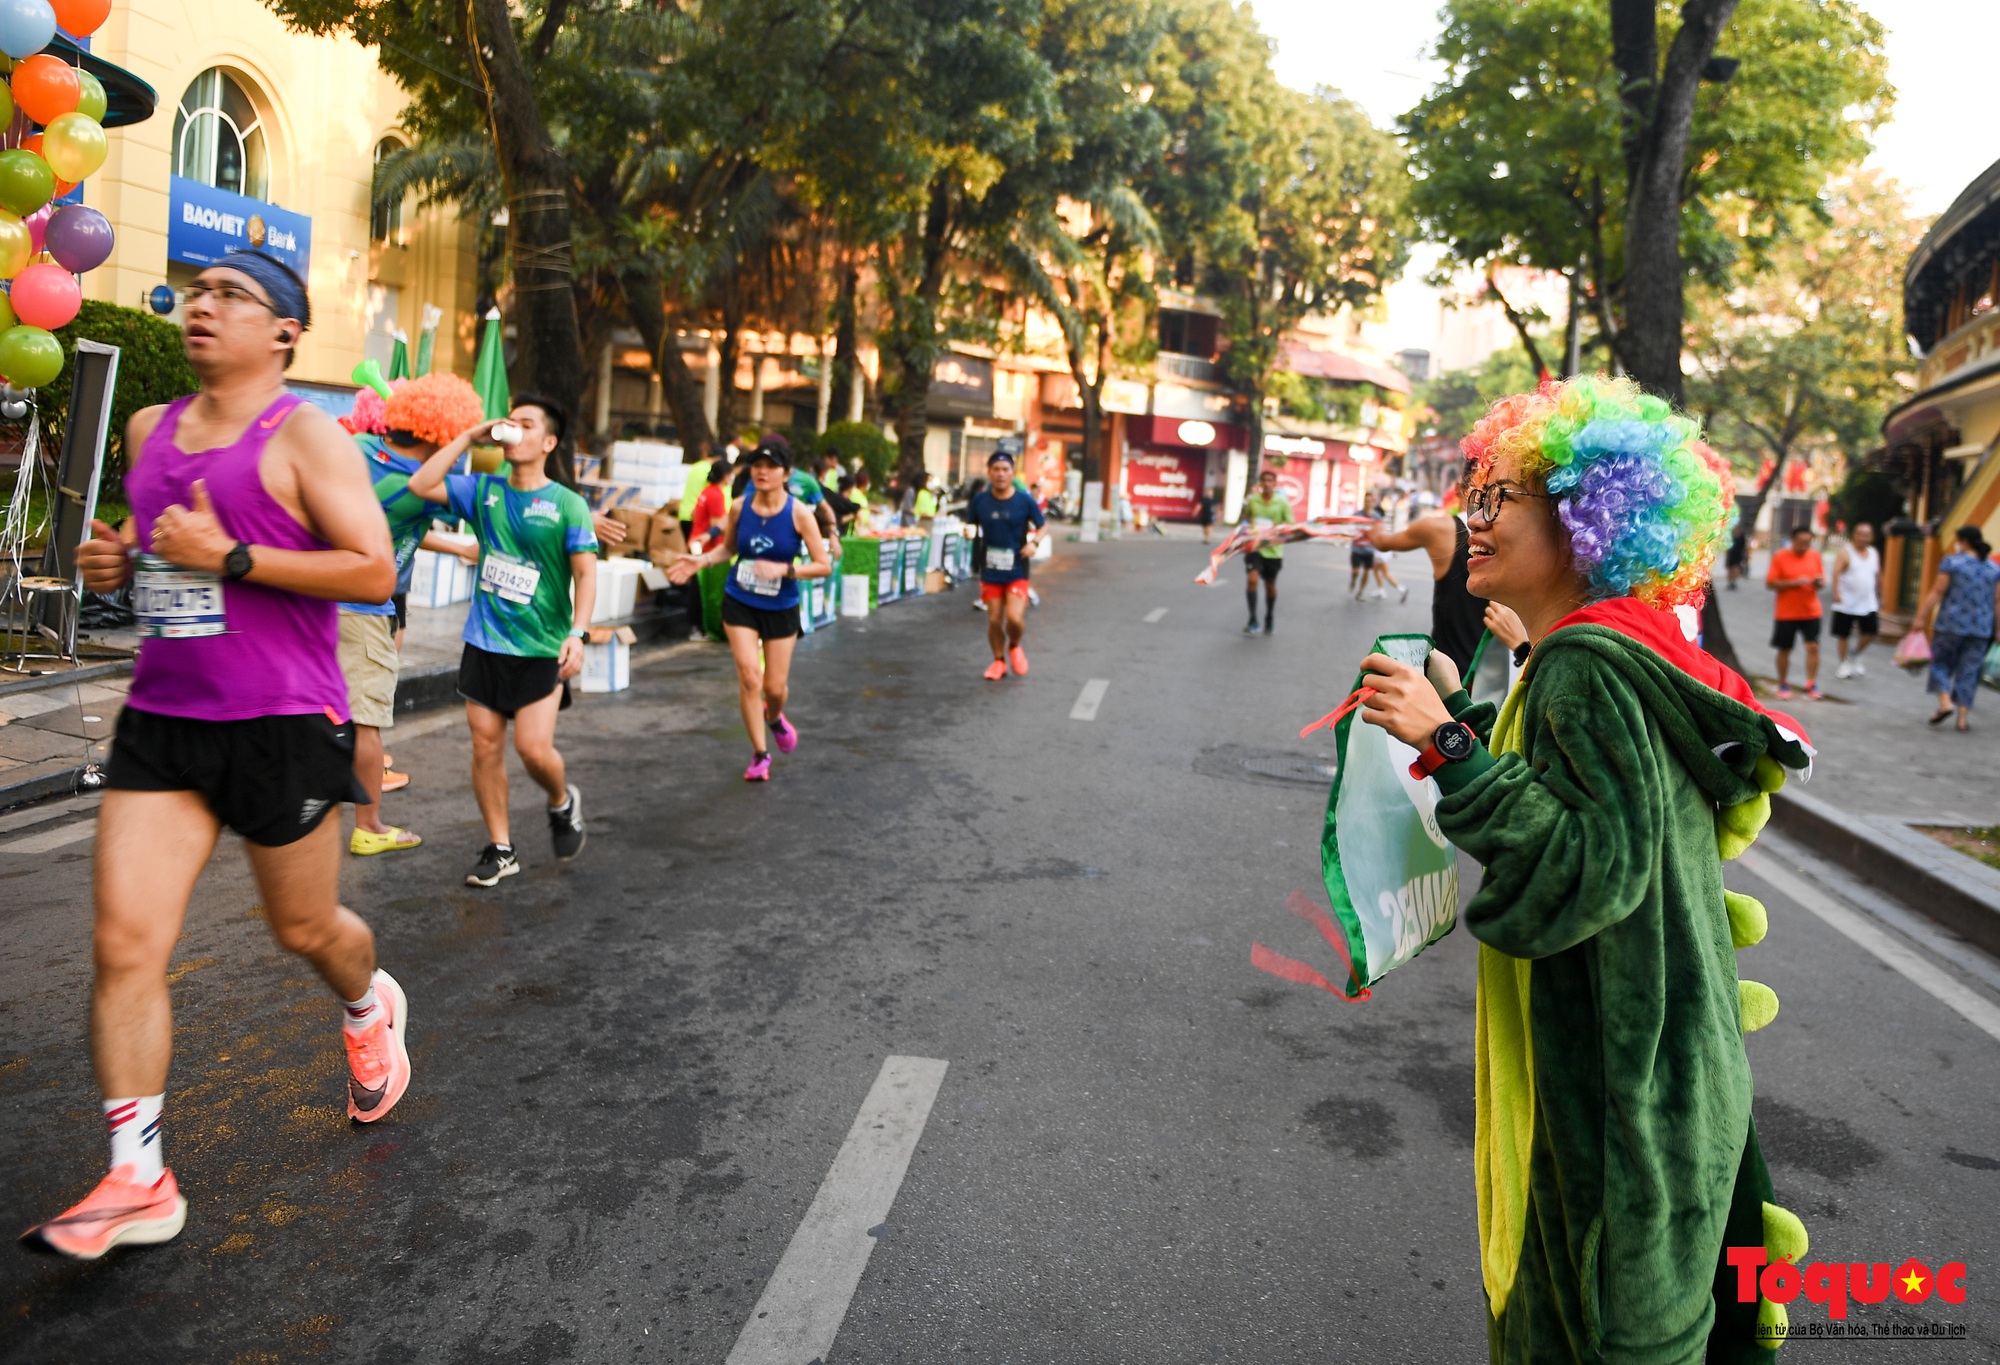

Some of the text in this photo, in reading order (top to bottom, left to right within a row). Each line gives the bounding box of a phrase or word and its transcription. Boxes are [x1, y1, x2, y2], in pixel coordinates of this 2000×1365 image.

[183, 202, 297, 252] BAOVIET Bank
[498, 570, 532, 589] 21429
